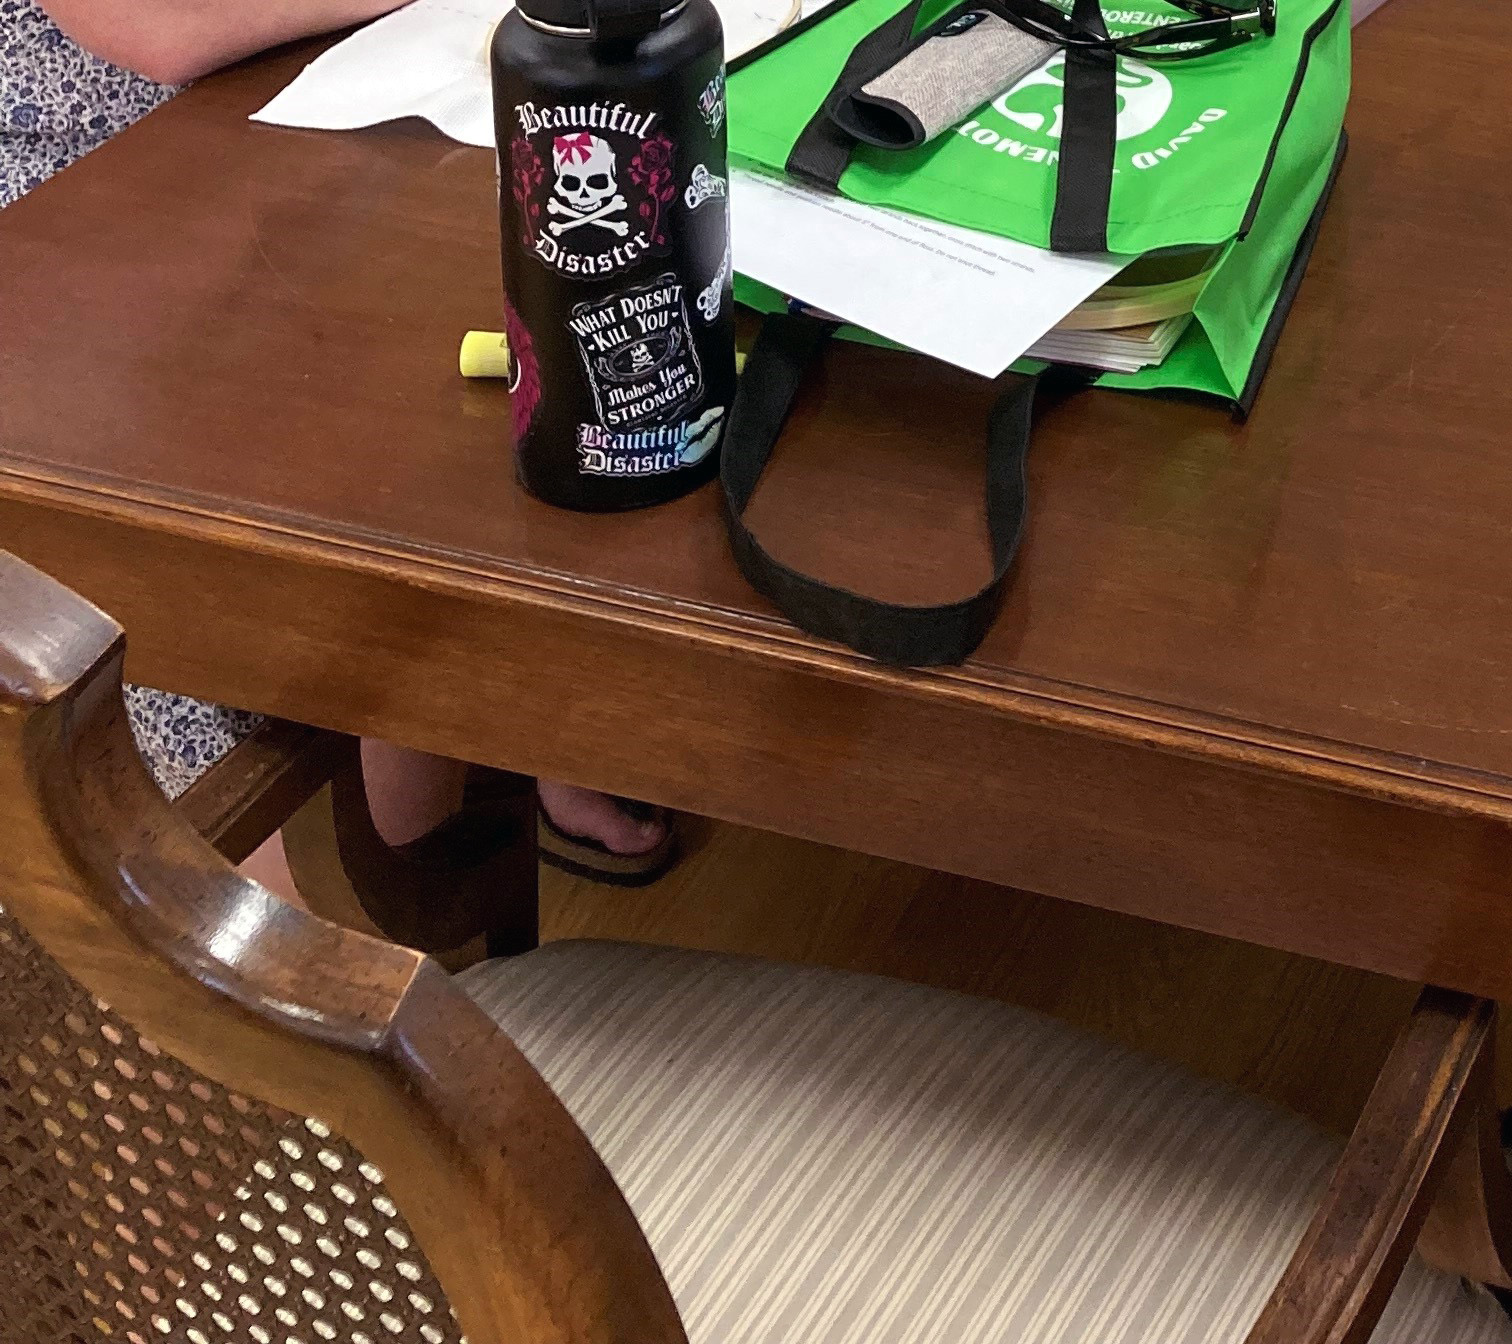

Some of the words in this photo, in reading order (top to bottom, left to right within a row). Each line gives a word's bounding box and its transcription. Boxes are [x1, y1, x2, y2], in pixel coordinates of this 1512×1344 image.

[515, 101, 656, 140] Beautiful
[1131, 108, 1228, 169] DAVID
[534, 229, 650, 274] Disaster
[570, 306, 618, 337] WHAT
[620, 285, 683, 318] DOESN'T
[592, 324, 631, 352] KILL
[637, 311, 669, 334] YOU
[607, 382, 657, 406] Makes
[659, 363, 687, 388] You
[607, 373, 696, 425] STRONGER
[580, 420, 689, 450] Beautiful
[580, 447, 685, 473] Disaster
